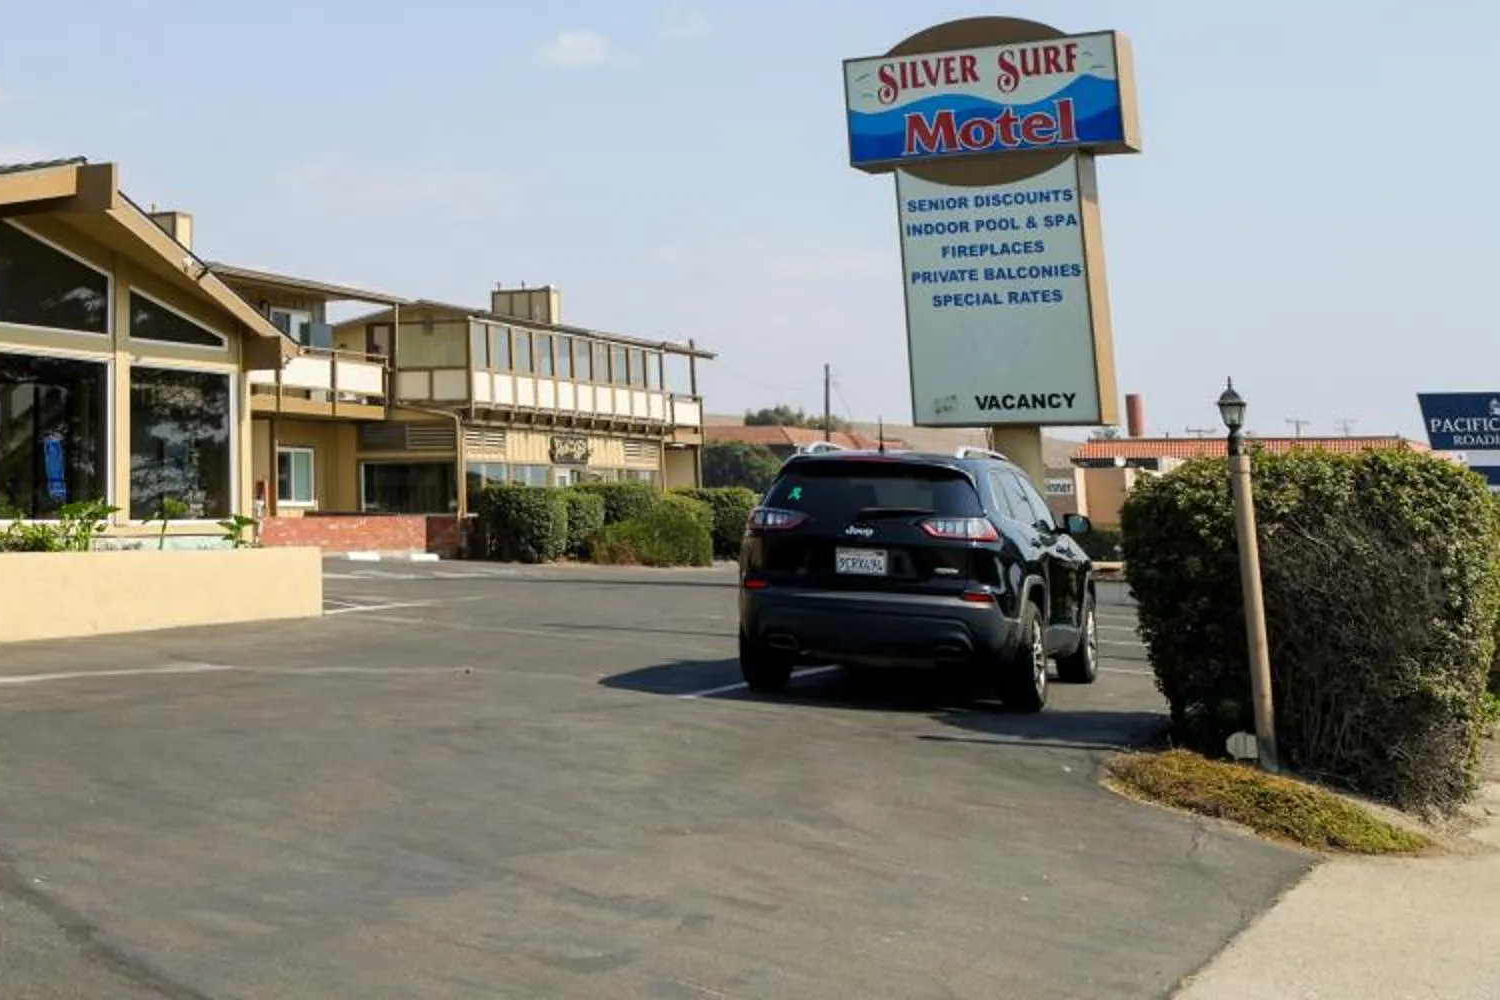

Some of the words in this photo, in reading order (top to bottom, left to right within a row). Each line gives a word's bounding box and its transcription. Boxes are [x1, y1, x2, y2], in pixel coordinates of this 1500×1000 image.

[877, 55, 980, 104] SILVER
[997, 43, 1078, 93] SURF
[902, 97, 1079, 156] Motel
[907, 196, 969, 213] SENIOR
[974, 188, 1074, 209] DISCOUNTS
[906, 221, 970, 237] INDOOR
[975, 217, 1020, 233] POOL
[1025, 216, 1038, 229] &
[1043, 213, 1078, 228] SPA
[941, 240, 1045, 259] FIREPLACES
[911, 269, 979, 284] PRIVATE
[984, 263, 1082, 281] BALCONIES
[932, 293, 1003, 308] SPECIAL
[1007, 289, 1063, 305] RATES
[974, 392, 1077, 411] VACANCY
[845, 525, 875, 537] Jeep
